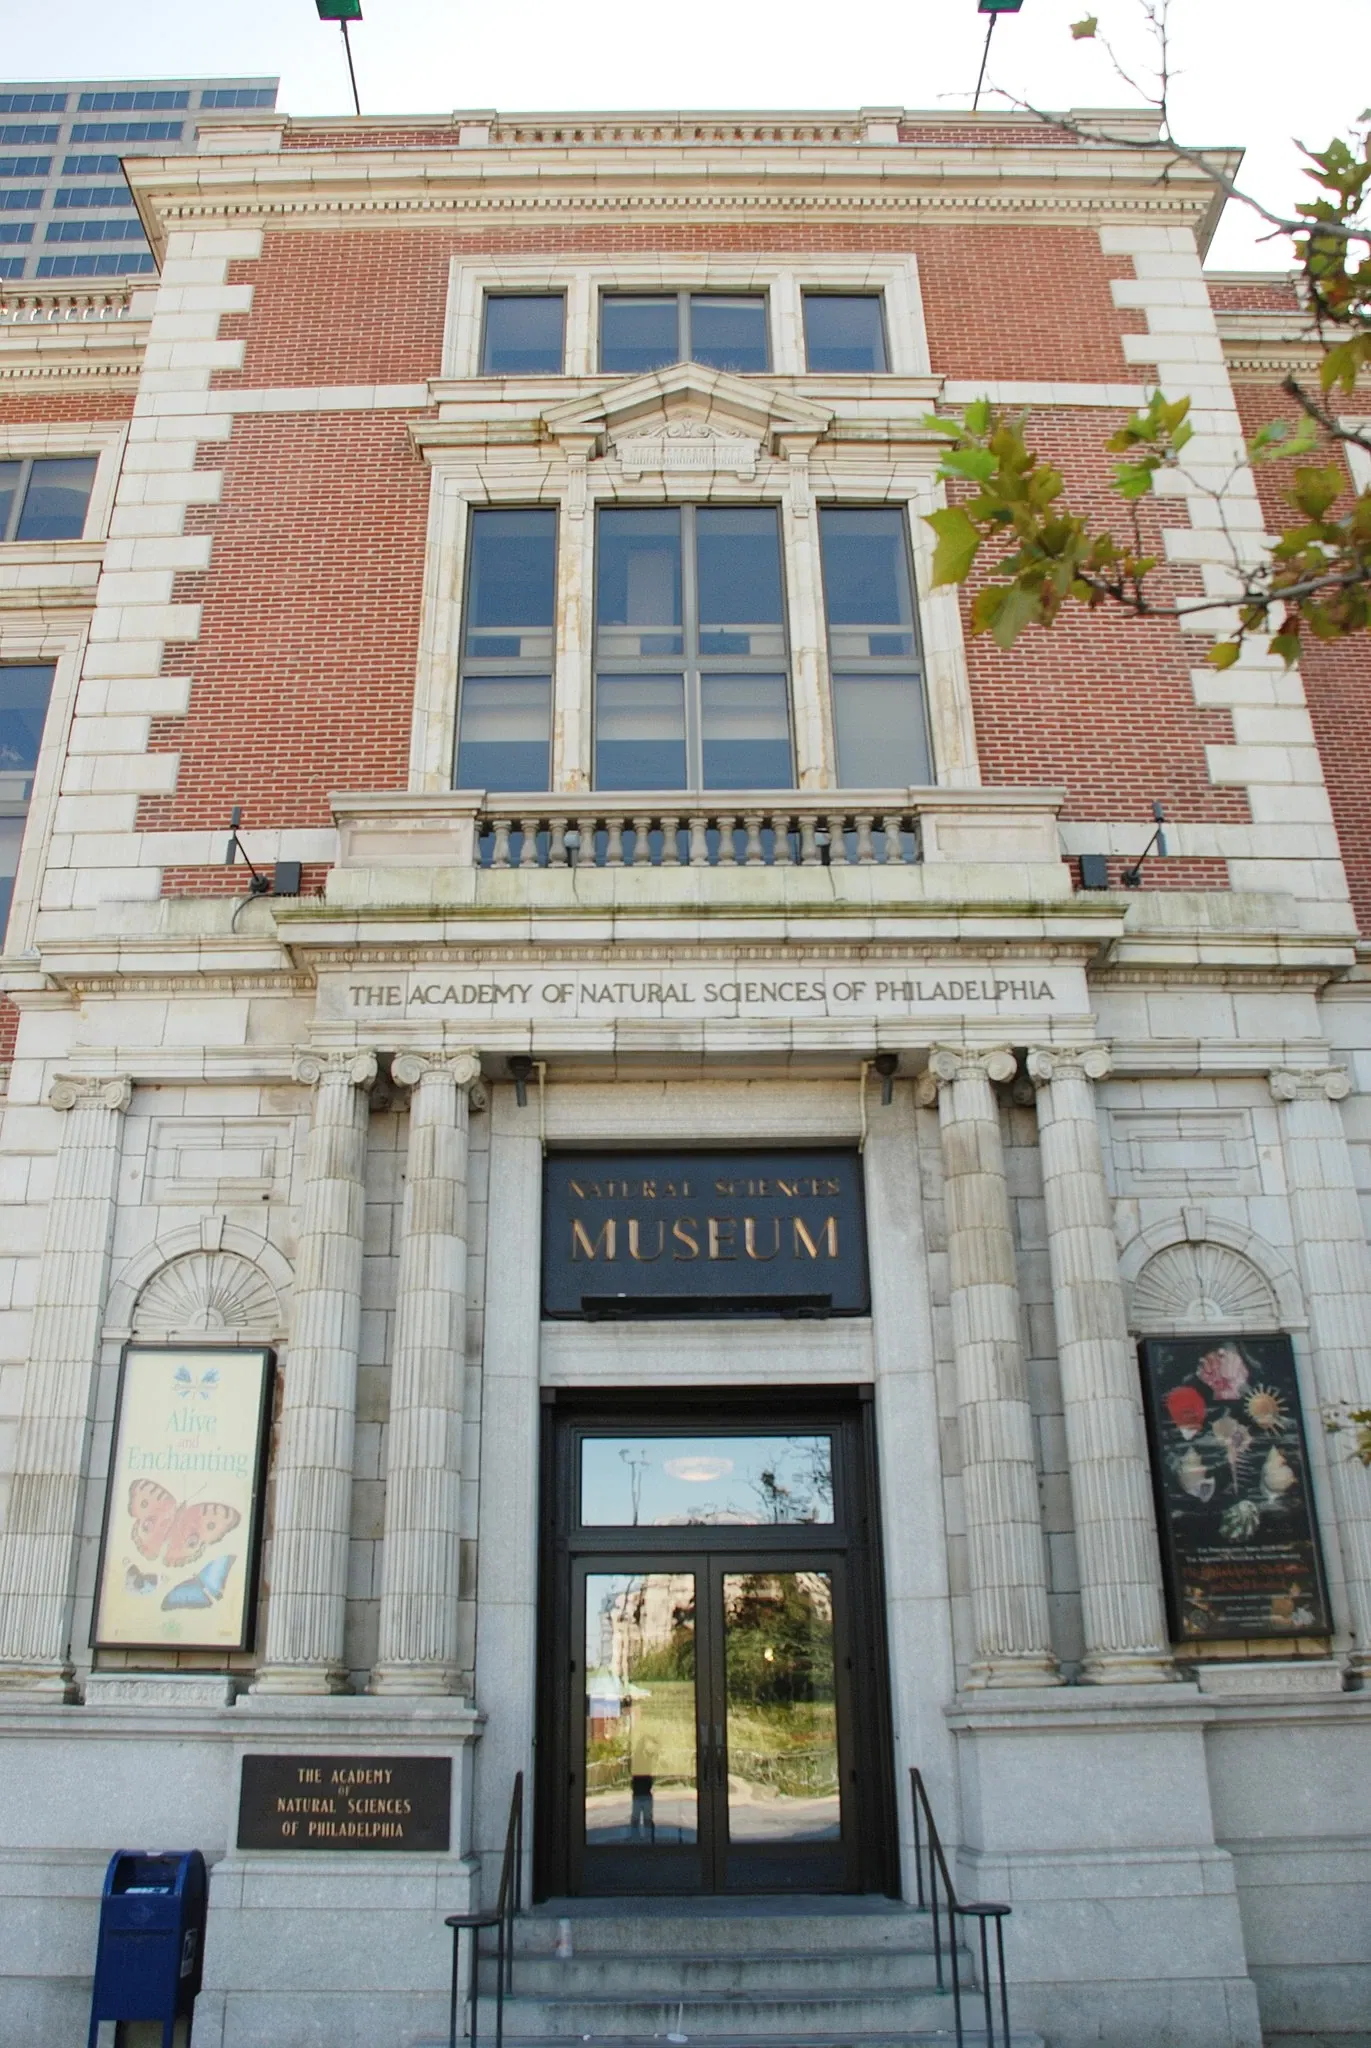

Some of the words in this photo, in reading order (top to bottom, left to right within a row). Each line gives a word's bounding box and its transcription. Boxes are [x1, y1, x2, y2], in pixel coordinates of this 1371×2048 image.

[350, 985, 402, 1007] THE
[408, 983, 532, 1005] ACADEMY
[542, 983, 575, 1004] OF
[579, 983, 696, 1004] NATURAL
[704, 982, 827, 1003] SCIENCES
[832, 981, 867, 1002] OF
[876, 980, 1055, 1001] PHILADELPHIA
[568, 1179, 694, 1199] NATURAL
[714, 1177, 840, 1199] SCIENCES
[569, 1214, 840, 1263] MUSEUM
[165, 1407, 217, 1433] Alive
[176, 1435, 200, 1449] and
[127, 1444, 249, 1479] Enchanting
[298, 1768, 322, 1784] THE
[331, 1768, 393, 1784] ACADEMY
[277, 1798, 337, 1814] NATURAL
[348, 1799, 412, 1814] SCIENCES
[281, 1821, 299, 1837] OF
[308, 1821, 404, 1838] PHILADELPHIA
